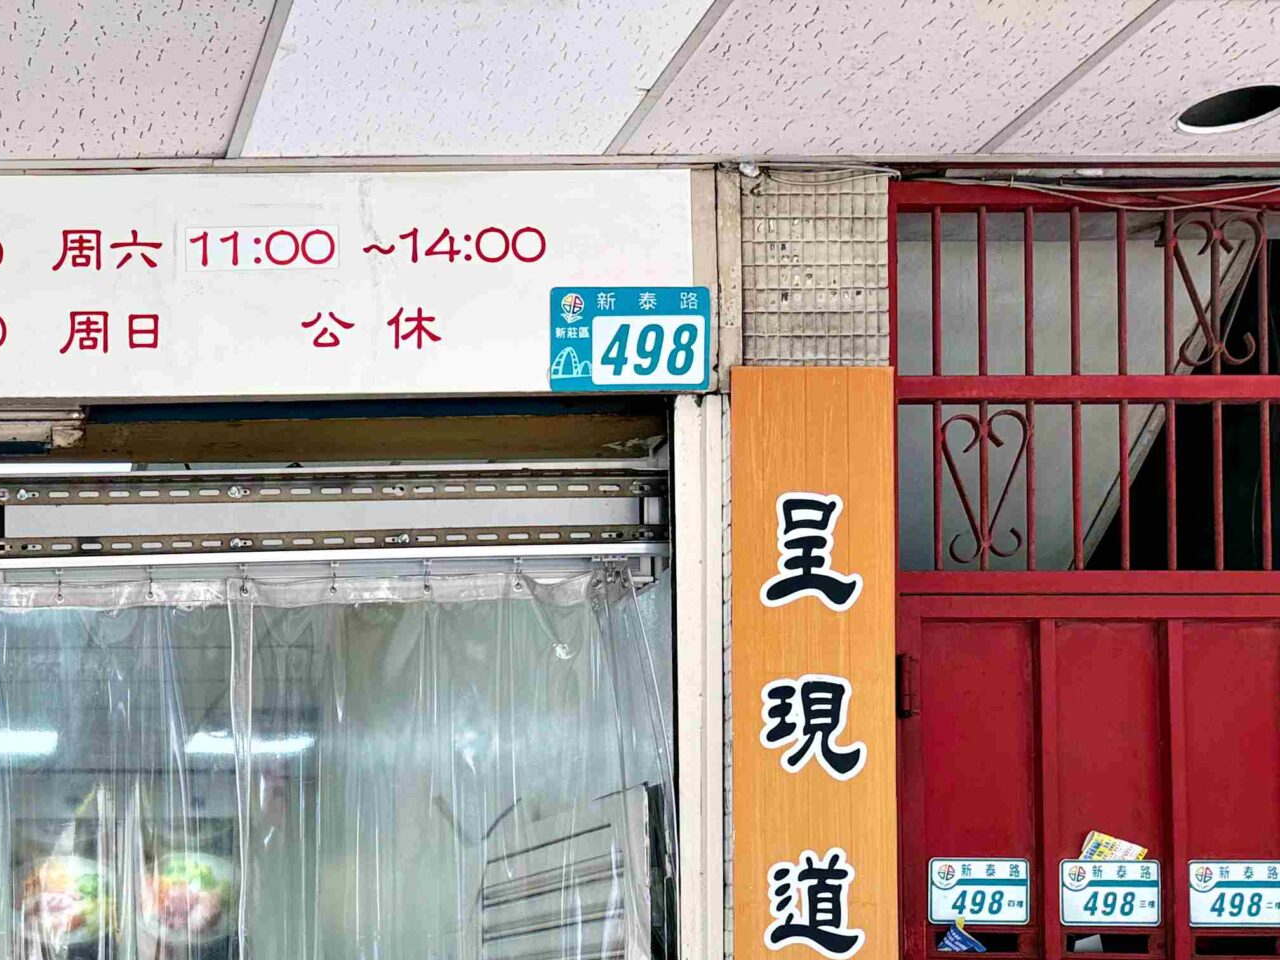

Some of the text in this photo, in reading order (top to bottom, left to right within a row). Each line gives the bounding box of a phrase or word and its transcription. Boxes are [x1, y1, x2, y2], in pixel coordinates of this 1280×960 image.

[51, 228, 164, 273] 周六
[189, 228, 336, 267] 11:00
[596, 291, 699, 311] 新泰路
[58, 310, 161, 355] 周日
[300, 305, 443, 351] 公休
[554, 326, 591, 340] 新莊區
[600, 323, 698, 377] 498
[960, 863, 1021, 878] 新泰路
[1091, 864, 1152, 880] 新泰路
[1218, 865, 1280, 880] 新泰路
[951, 889, 1005, 915] 498
[1082, 890, 1137, 917] 498
[1209, 891, 1263, 918] 498
